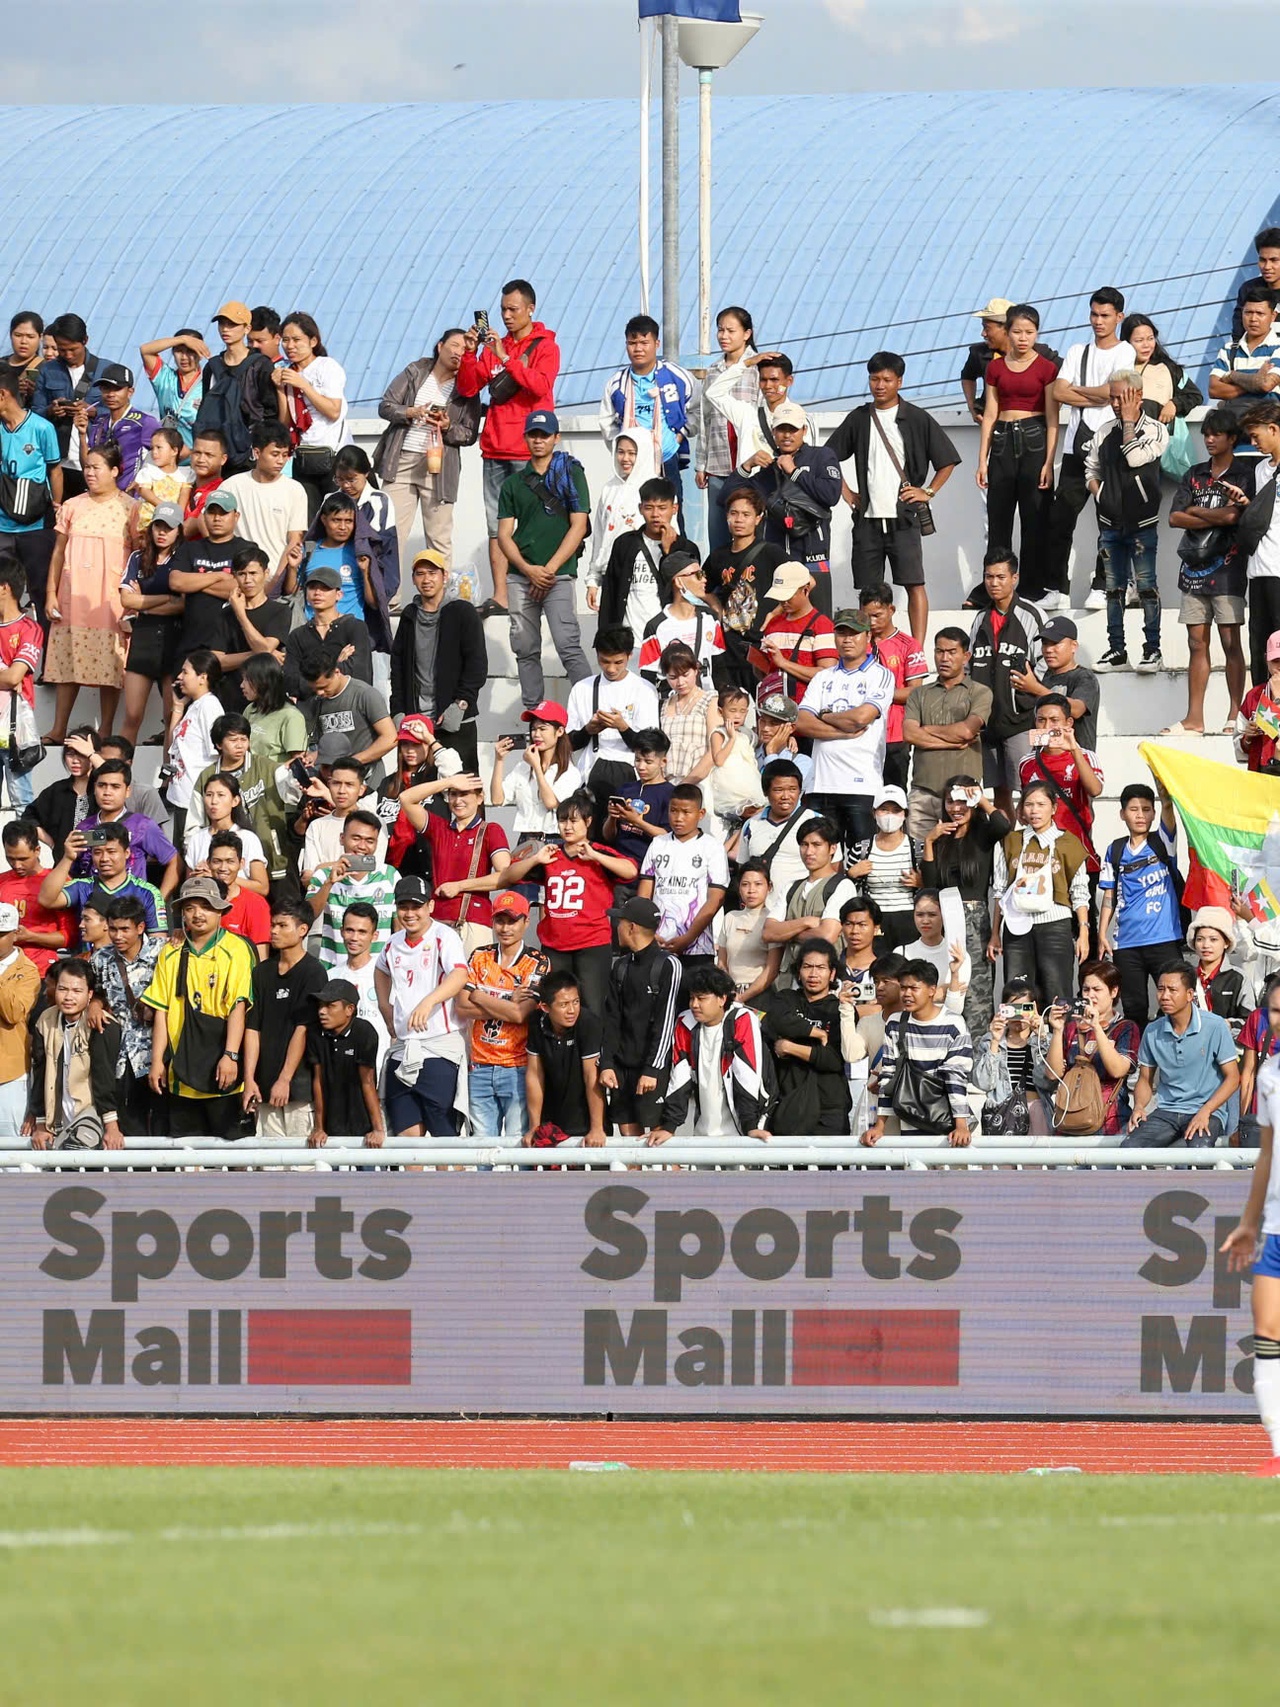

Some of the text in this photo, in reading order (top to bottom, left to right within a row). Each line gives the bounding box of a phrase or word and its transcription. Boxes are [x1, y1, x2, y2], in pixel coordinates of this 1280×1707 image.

[655, 854, 671, 869] 99
[669, 876, 687, 888] KING
[547, 876, 586, 910] 32
[1146, 901, 1162, 915] FC
[38, 1186, 413, 1302] Sports
[580, 1185, 963, 1302] Sports
[42, 1309, 242, 1386] Mall
[583, 1309, 787, 1387] Mall
